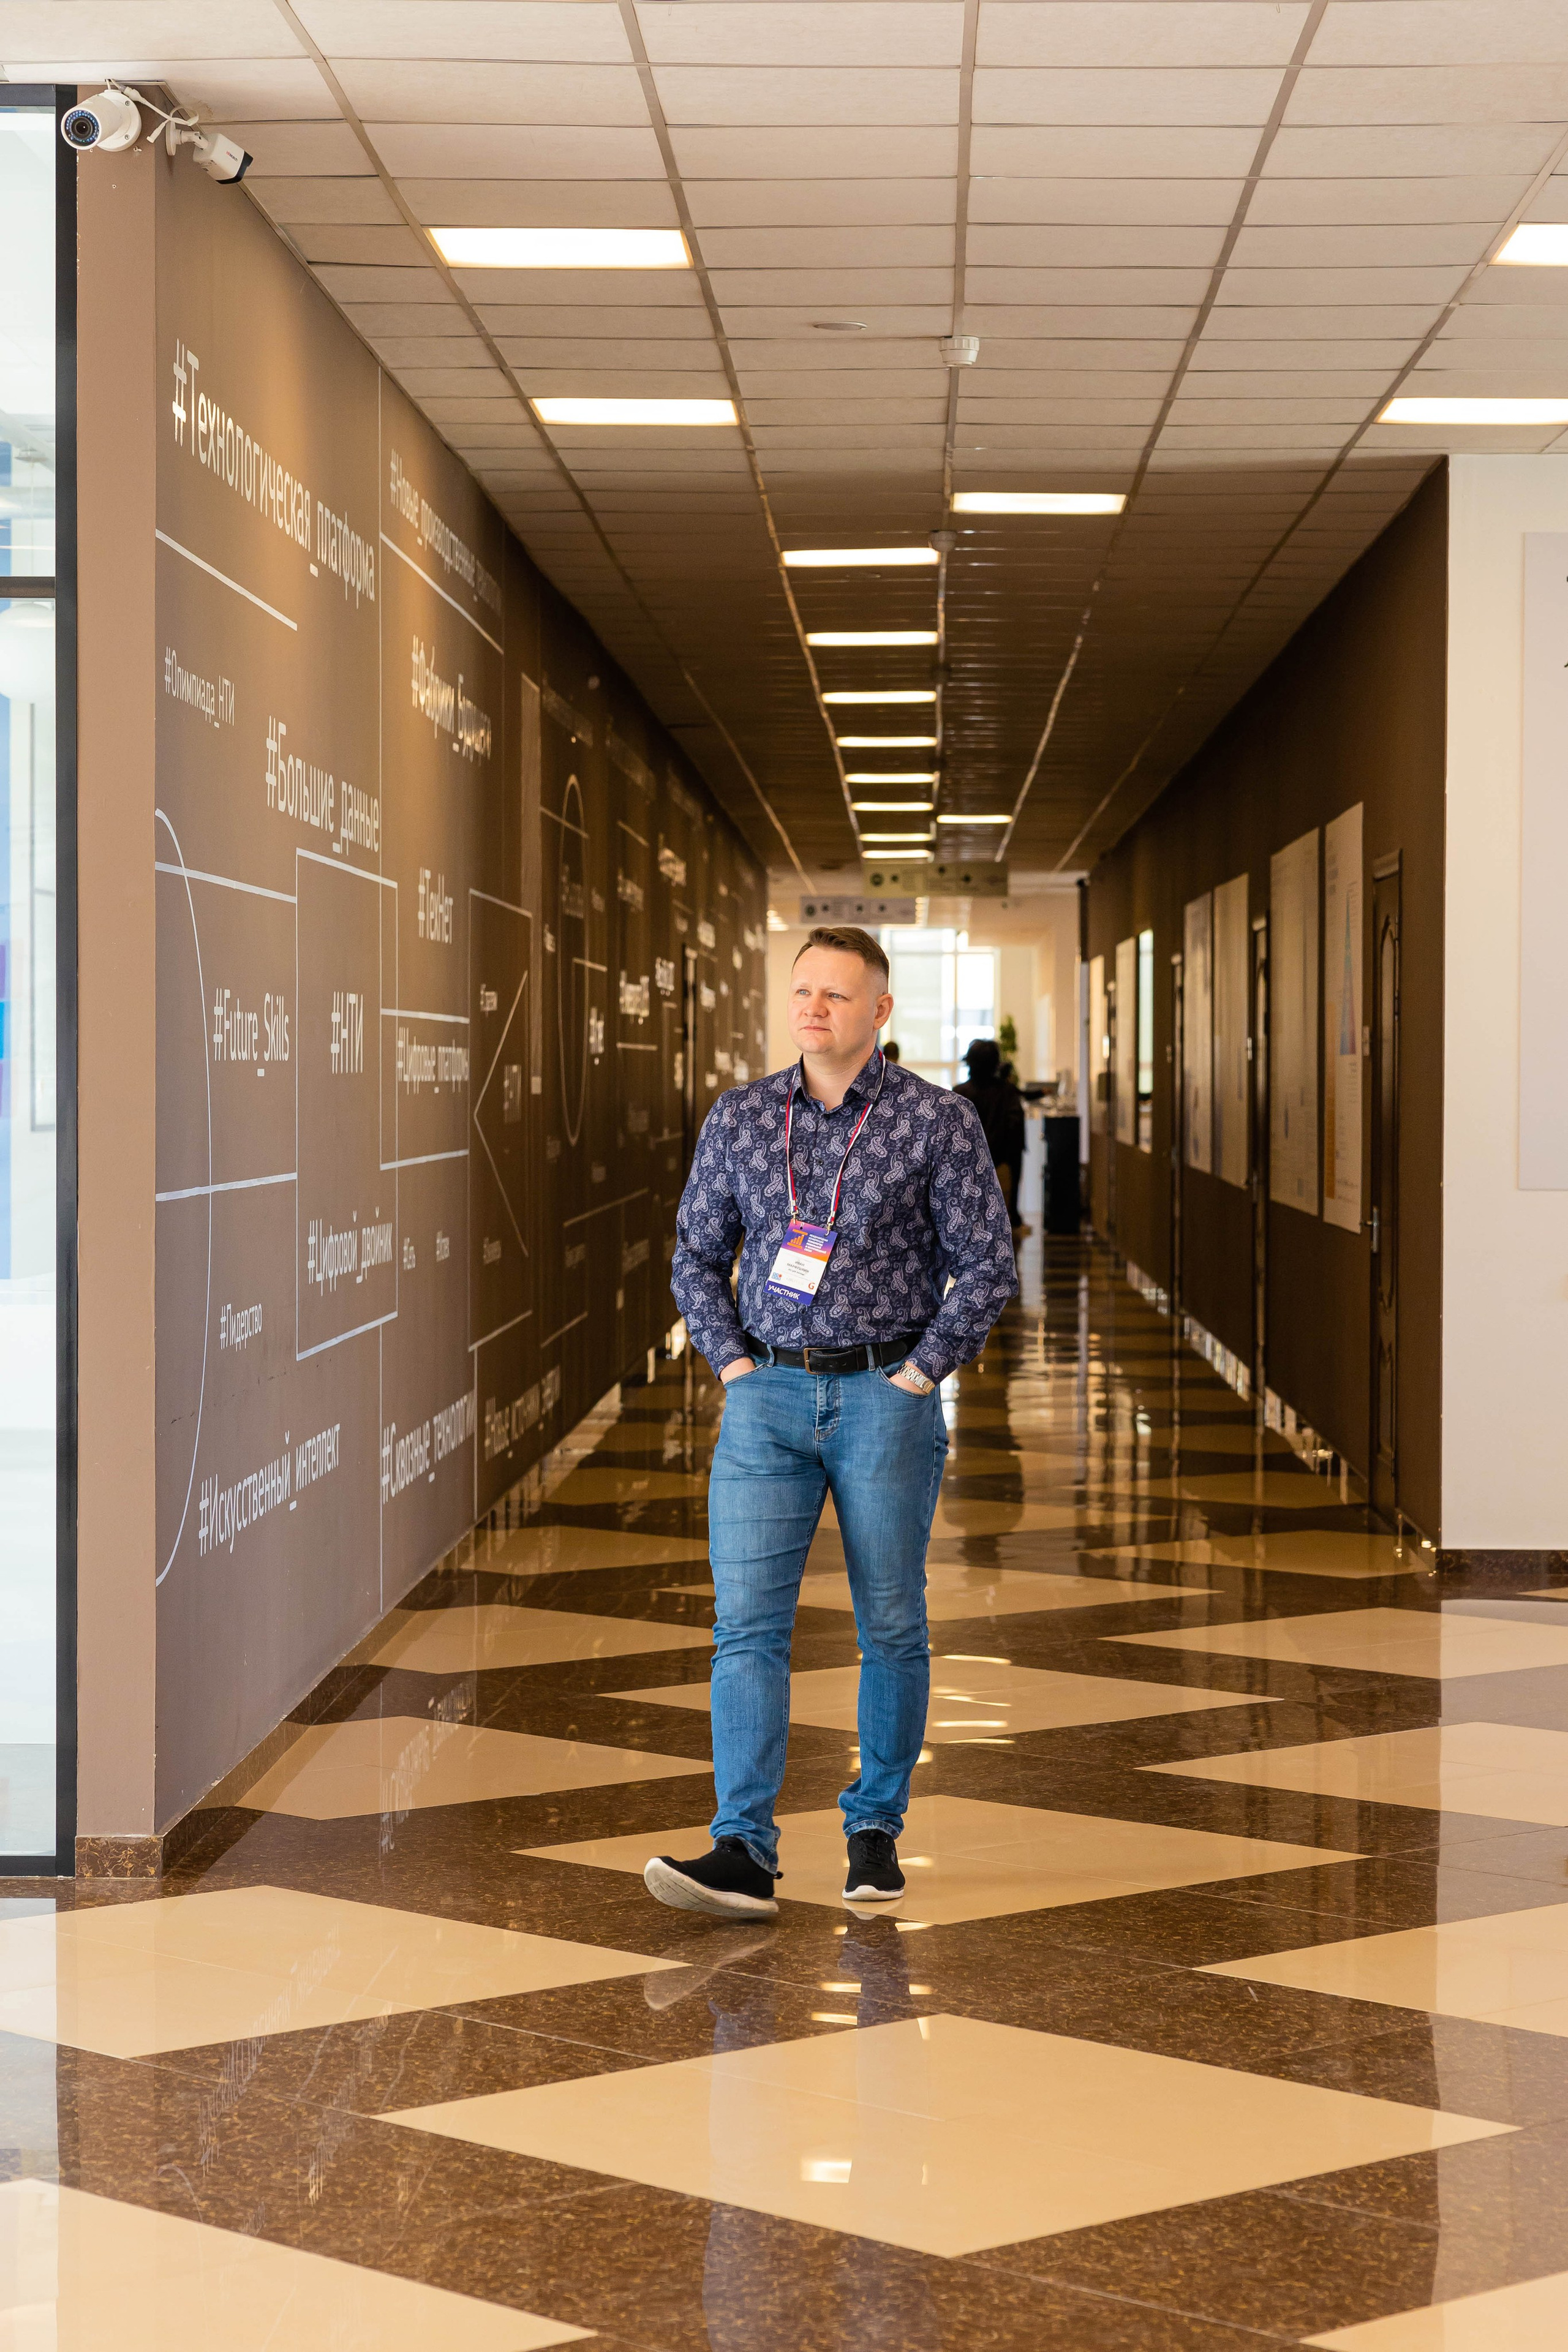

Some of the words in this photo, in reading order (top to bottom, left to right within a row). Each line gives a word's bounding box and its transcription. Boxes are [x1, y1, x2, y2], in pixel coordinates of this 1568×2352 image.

[172, 338, 375, 610] #Технологическая_платформа
[164, 646, 235, 728] #Олимпиада_НТИ
[266, 715, 379, 856] #Большие_данные
[418, 867, 454, 944] #ТехНет
[213, 987, 290, 1077] #Future_Skills
[331, 991, 363, 1074] #НТИ
[307, 1205, 393, 1297] #Цифровой_двойник
[768, 1284, 801, 1300] УЧАСТНИК
[221, 1303, 262, 1352] #Лидерство
[198, 1422, 341, 1557] #Искусственный_интеллект
